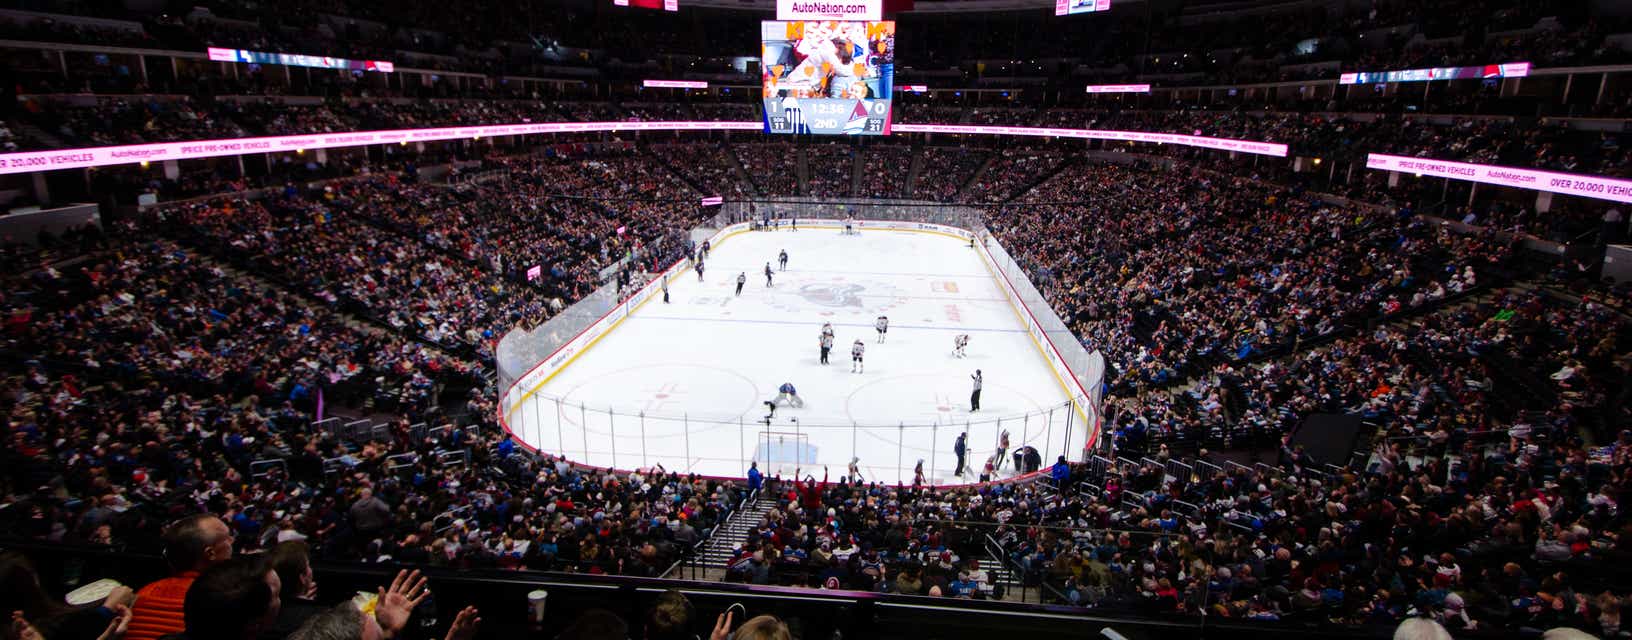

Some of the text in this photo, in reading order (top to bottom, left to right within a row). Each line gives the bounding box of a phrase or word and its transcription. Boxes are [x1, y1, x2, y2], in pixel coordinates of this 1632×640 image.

[792, 2, 866, 13] AutoNation.com
[771, 101, 777, 113] 1
[874, 103, 885, 114] 0
[774, 122, 784, 130] 11
[814, 119, 837, 129] 2ND
[11, 157, 46, 168] 20,000
[49, 153, 94, 165] VEHICLES
[1415, 162, 1446, 173] PRE-OWNED
[1447, 166, 1476, 176] VEHICLES
[1487, 170, 1536, 182] AutoNation.com
[1550, 178, 1632, 197] OVER 20,000 VEHIC
